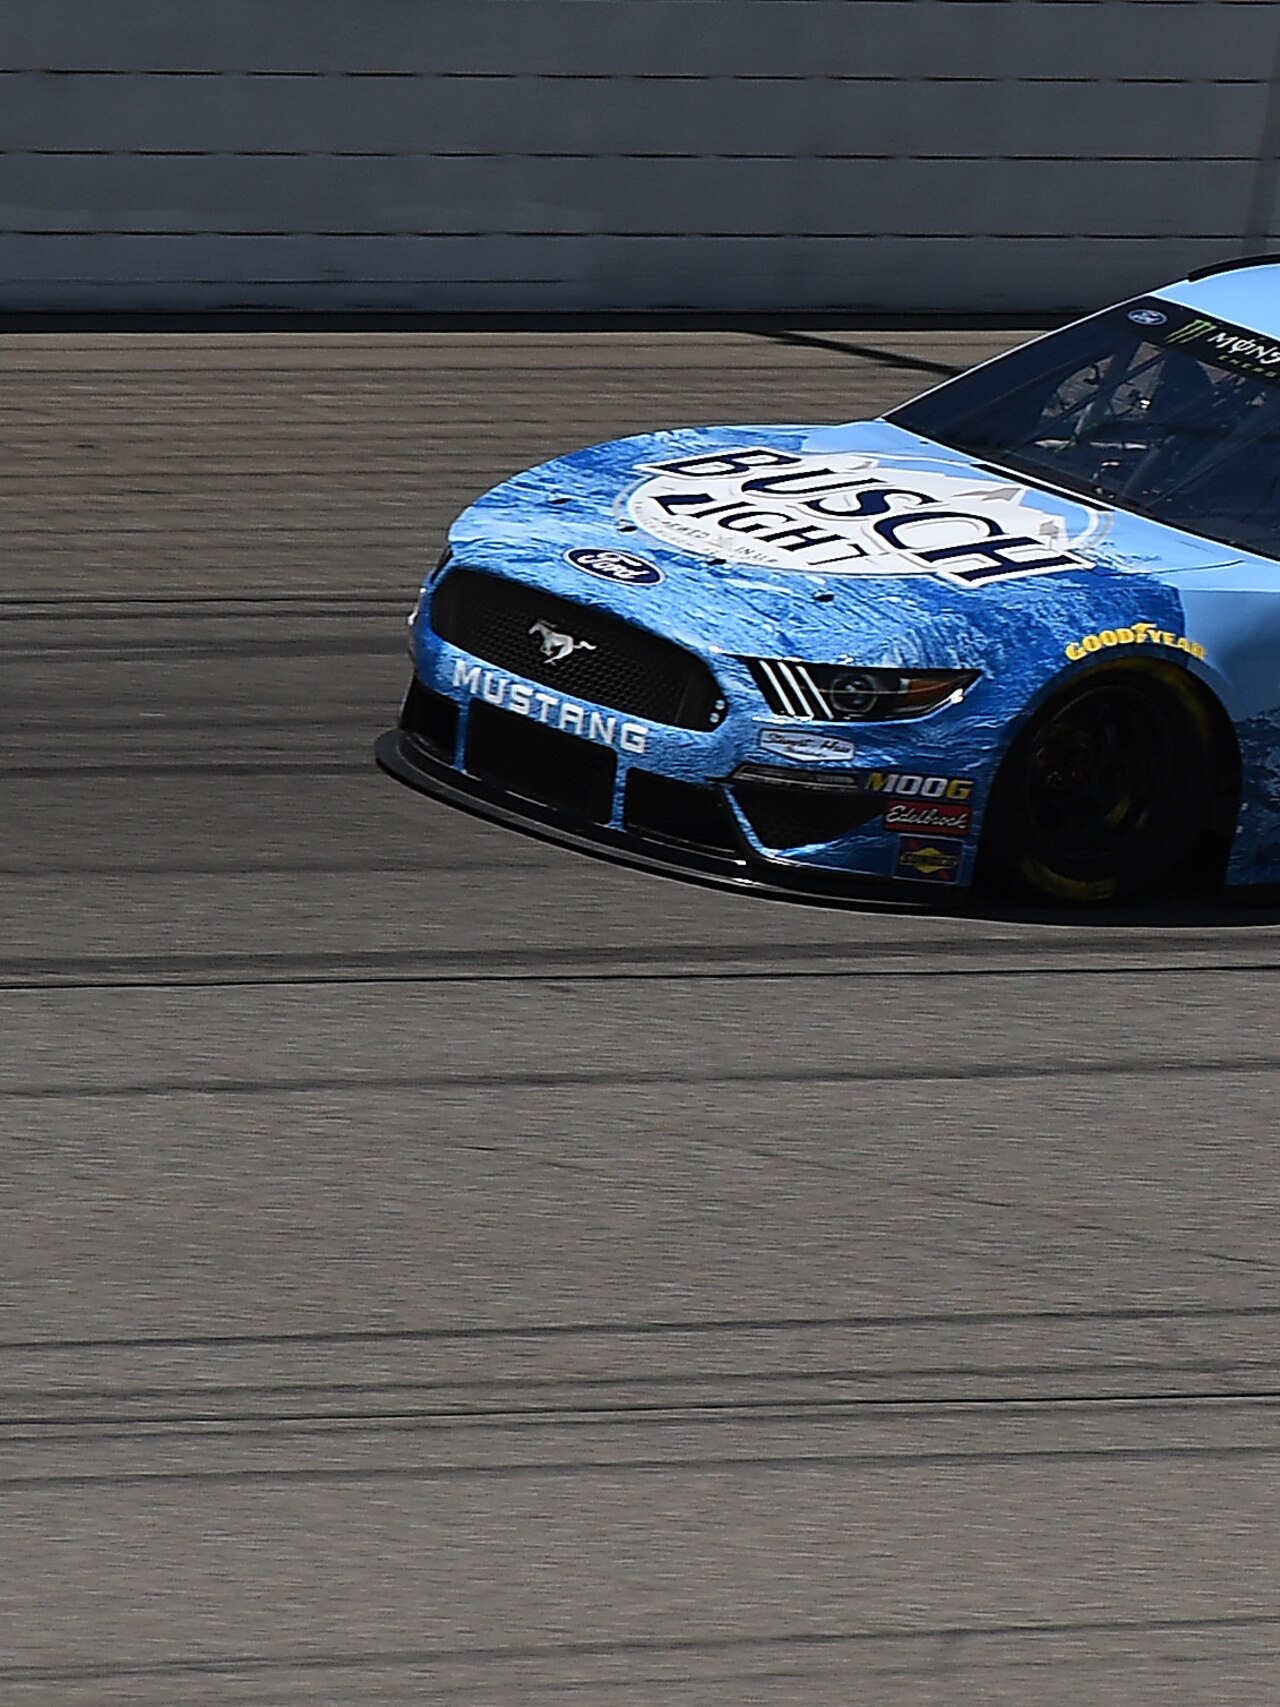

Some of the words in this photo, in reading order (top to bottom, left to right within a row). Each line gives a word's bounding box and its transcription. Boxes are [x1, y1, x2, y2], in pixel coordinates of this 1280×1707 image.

[647, 449, 1073, 582] BUSCH
[653, 493, 869, 566] LIGHT
[576, 552, 651, 581] Ford
[1064, 622, 1206, 661] GOODYEAR
[452, 660, 649, 753] MUSTANG
[864, 772, 975, 800] MOOG
[885, 804, 969, 829] Edelbrock
